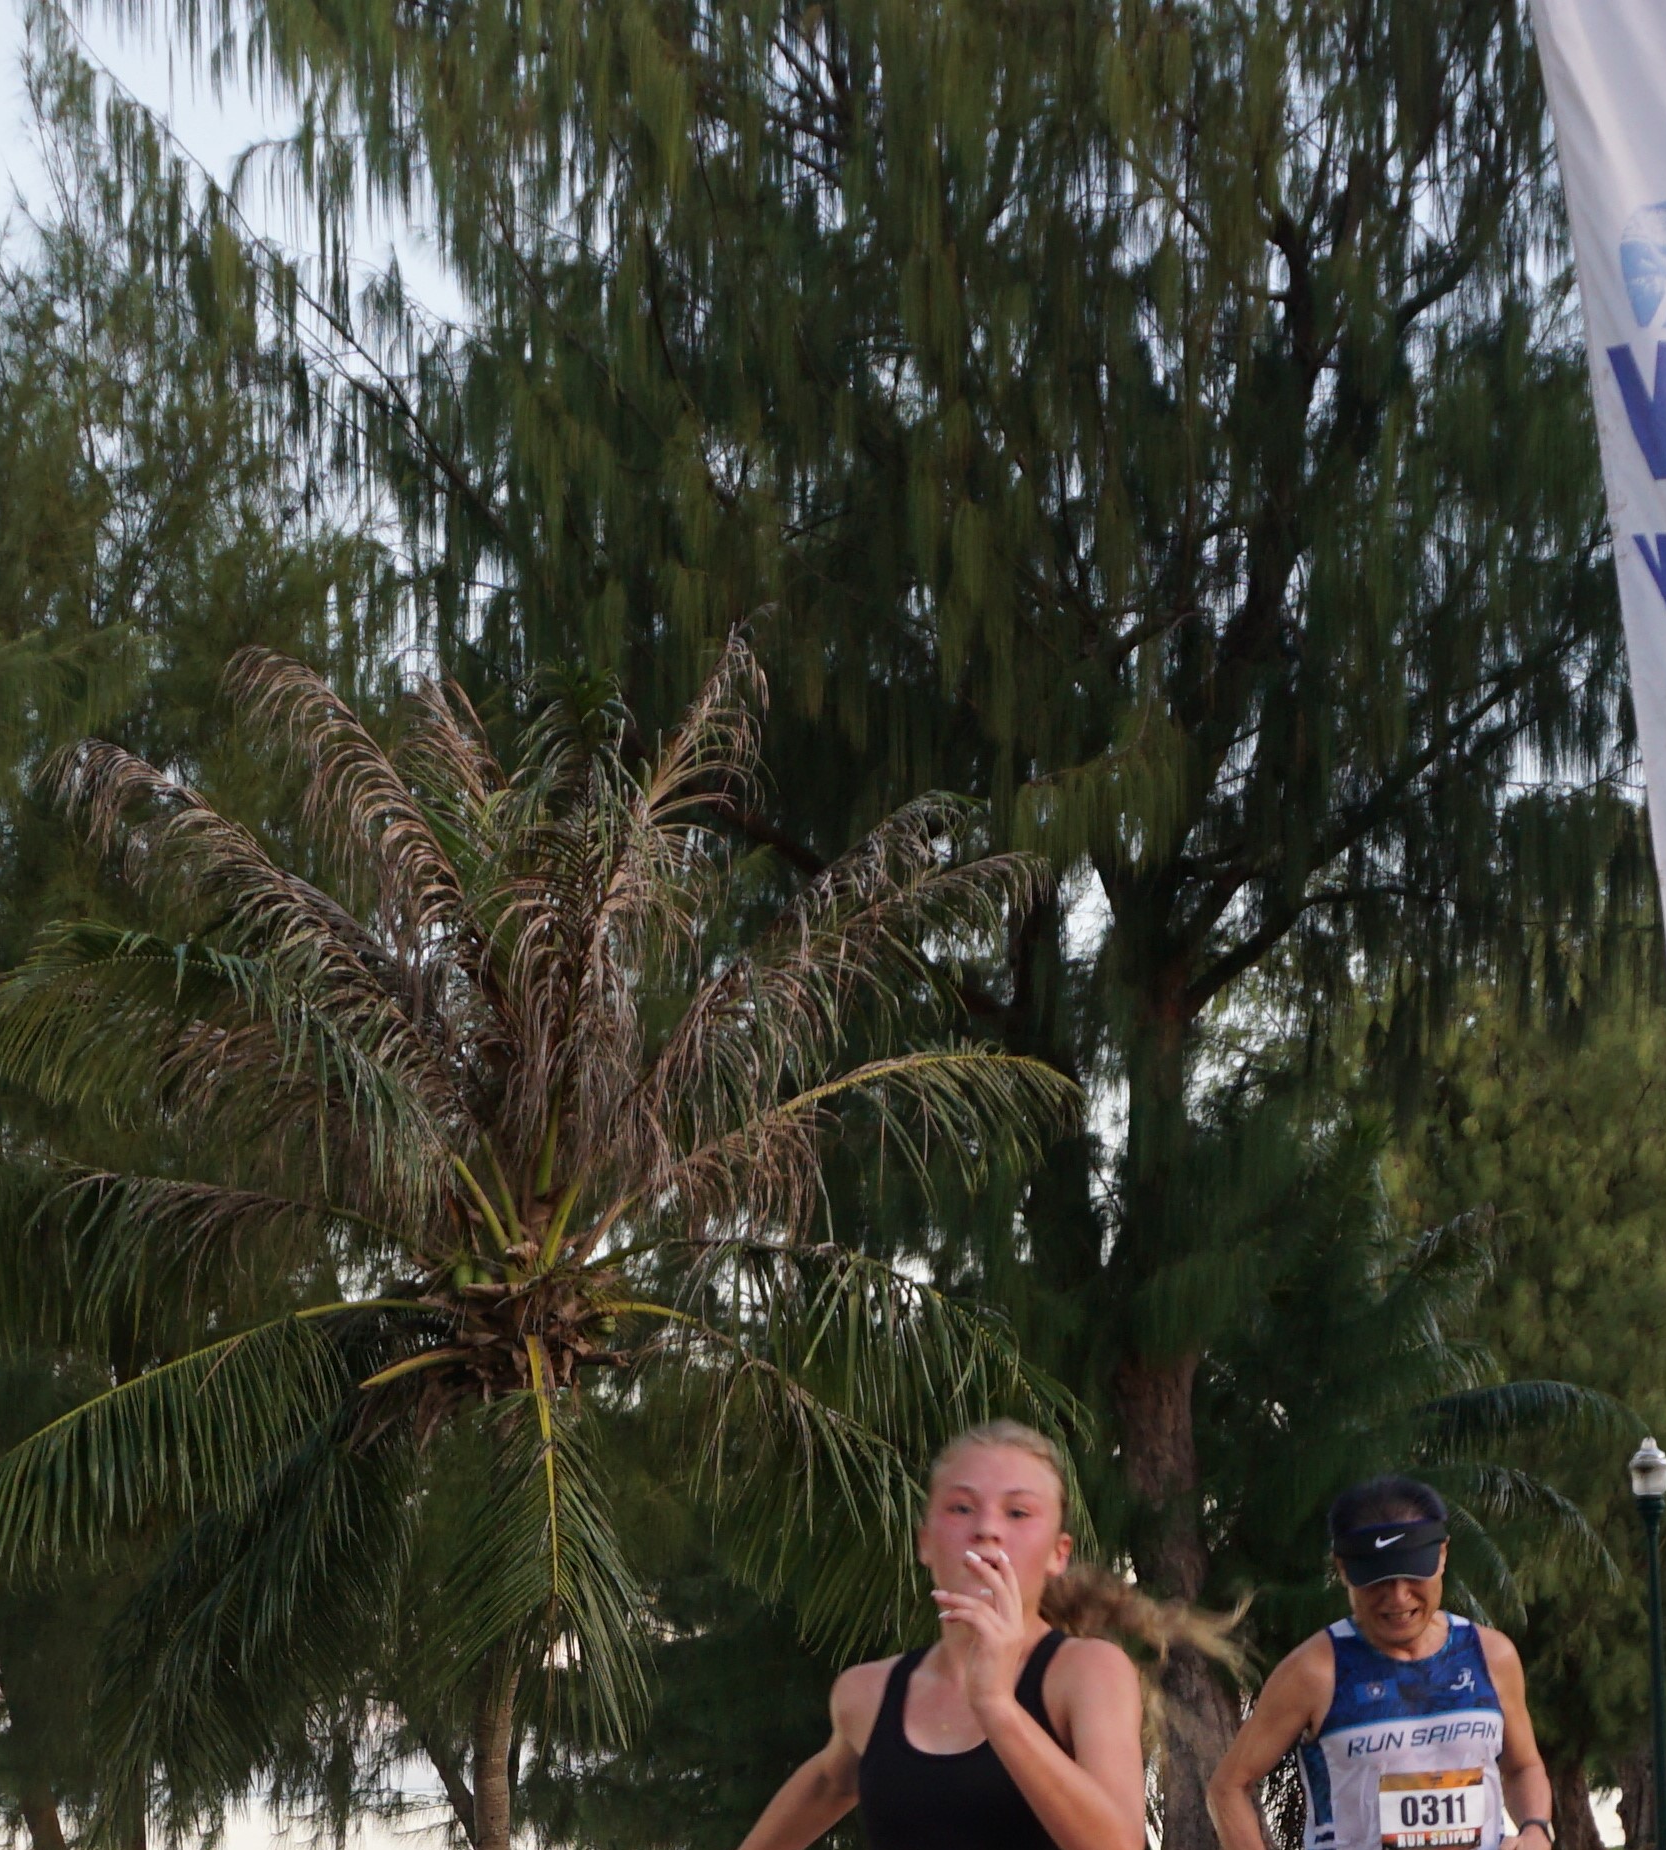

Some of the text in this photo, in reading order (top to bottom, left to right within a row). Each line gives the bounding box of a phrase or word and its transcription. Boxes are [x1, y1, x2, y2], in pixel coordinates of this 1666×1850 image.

[1348, 1721, 1498, 1758] RUN SAIPAN
[1400, 1792, 1466, 1827] 0311
[1396, 1828, 1476, 1848] RUN SAIPAN
